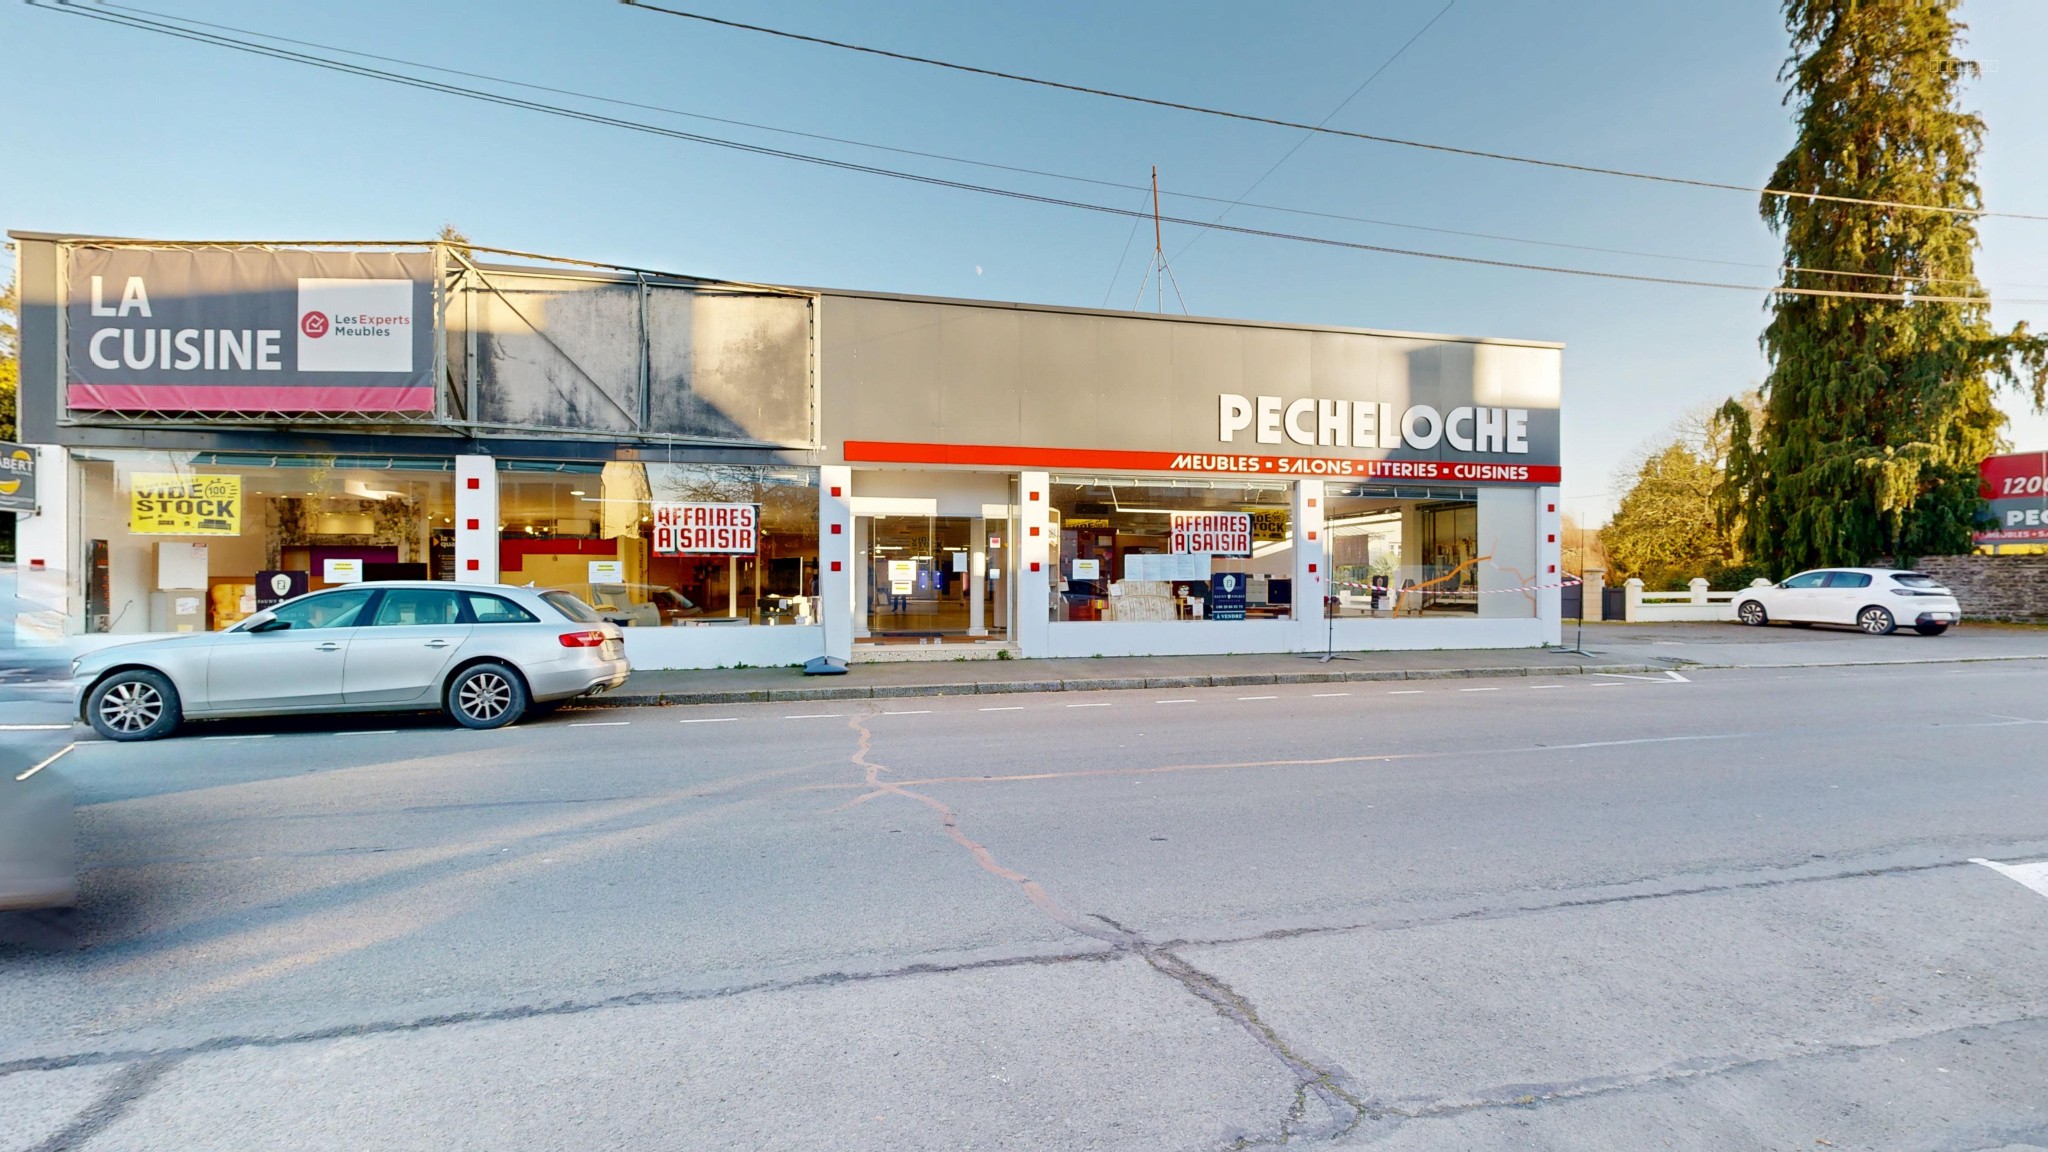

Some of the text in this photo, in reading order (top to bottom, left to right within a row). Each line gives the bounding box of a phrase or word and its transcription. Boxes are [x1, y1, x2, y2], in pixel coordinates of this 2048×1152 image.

[90, 275, 152, 317] LA
[335, 315, 410, 326] Les Experts
[335, 327, 390, 336] Meubles
[88, 328, 282, 371] CUISINE
[1218, 393, 1529, 454] PECHELOCHE
[0, 456, 34, 472] BERT
[1170, 454, 1529, 480] MEUBLES SALONS LITERIES CUISINES
[137, 484, 204, 499] VIDE
[137, 500, 235, 518] STOCK
[658, 507, 752, 527] AFFAIRES
[1175, 516, 1247, 532] AFFAIRES
[680, 528, 752, 549] SAISIR
[1192, 534, 1247, 551] SAISIR
